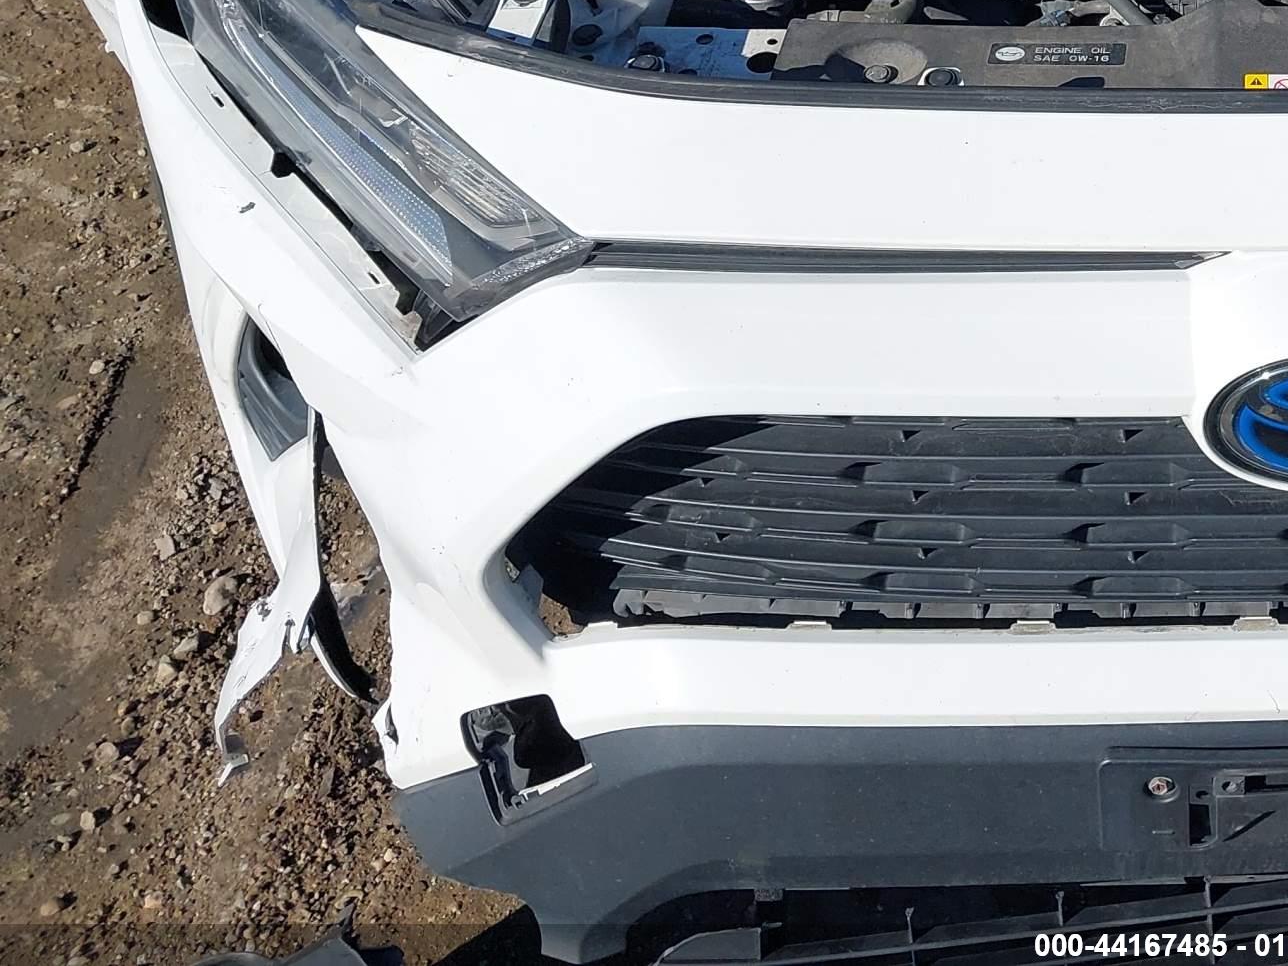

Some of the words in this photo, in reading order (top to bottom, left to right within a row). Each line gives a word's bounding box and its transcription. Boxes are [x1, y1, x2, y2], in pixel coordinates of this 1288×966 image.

[1034, 46, 1082, 54] ENGINE
[1091, 46, 1111, 54] OIL
[1033, 54, 1060, 62] SAE
